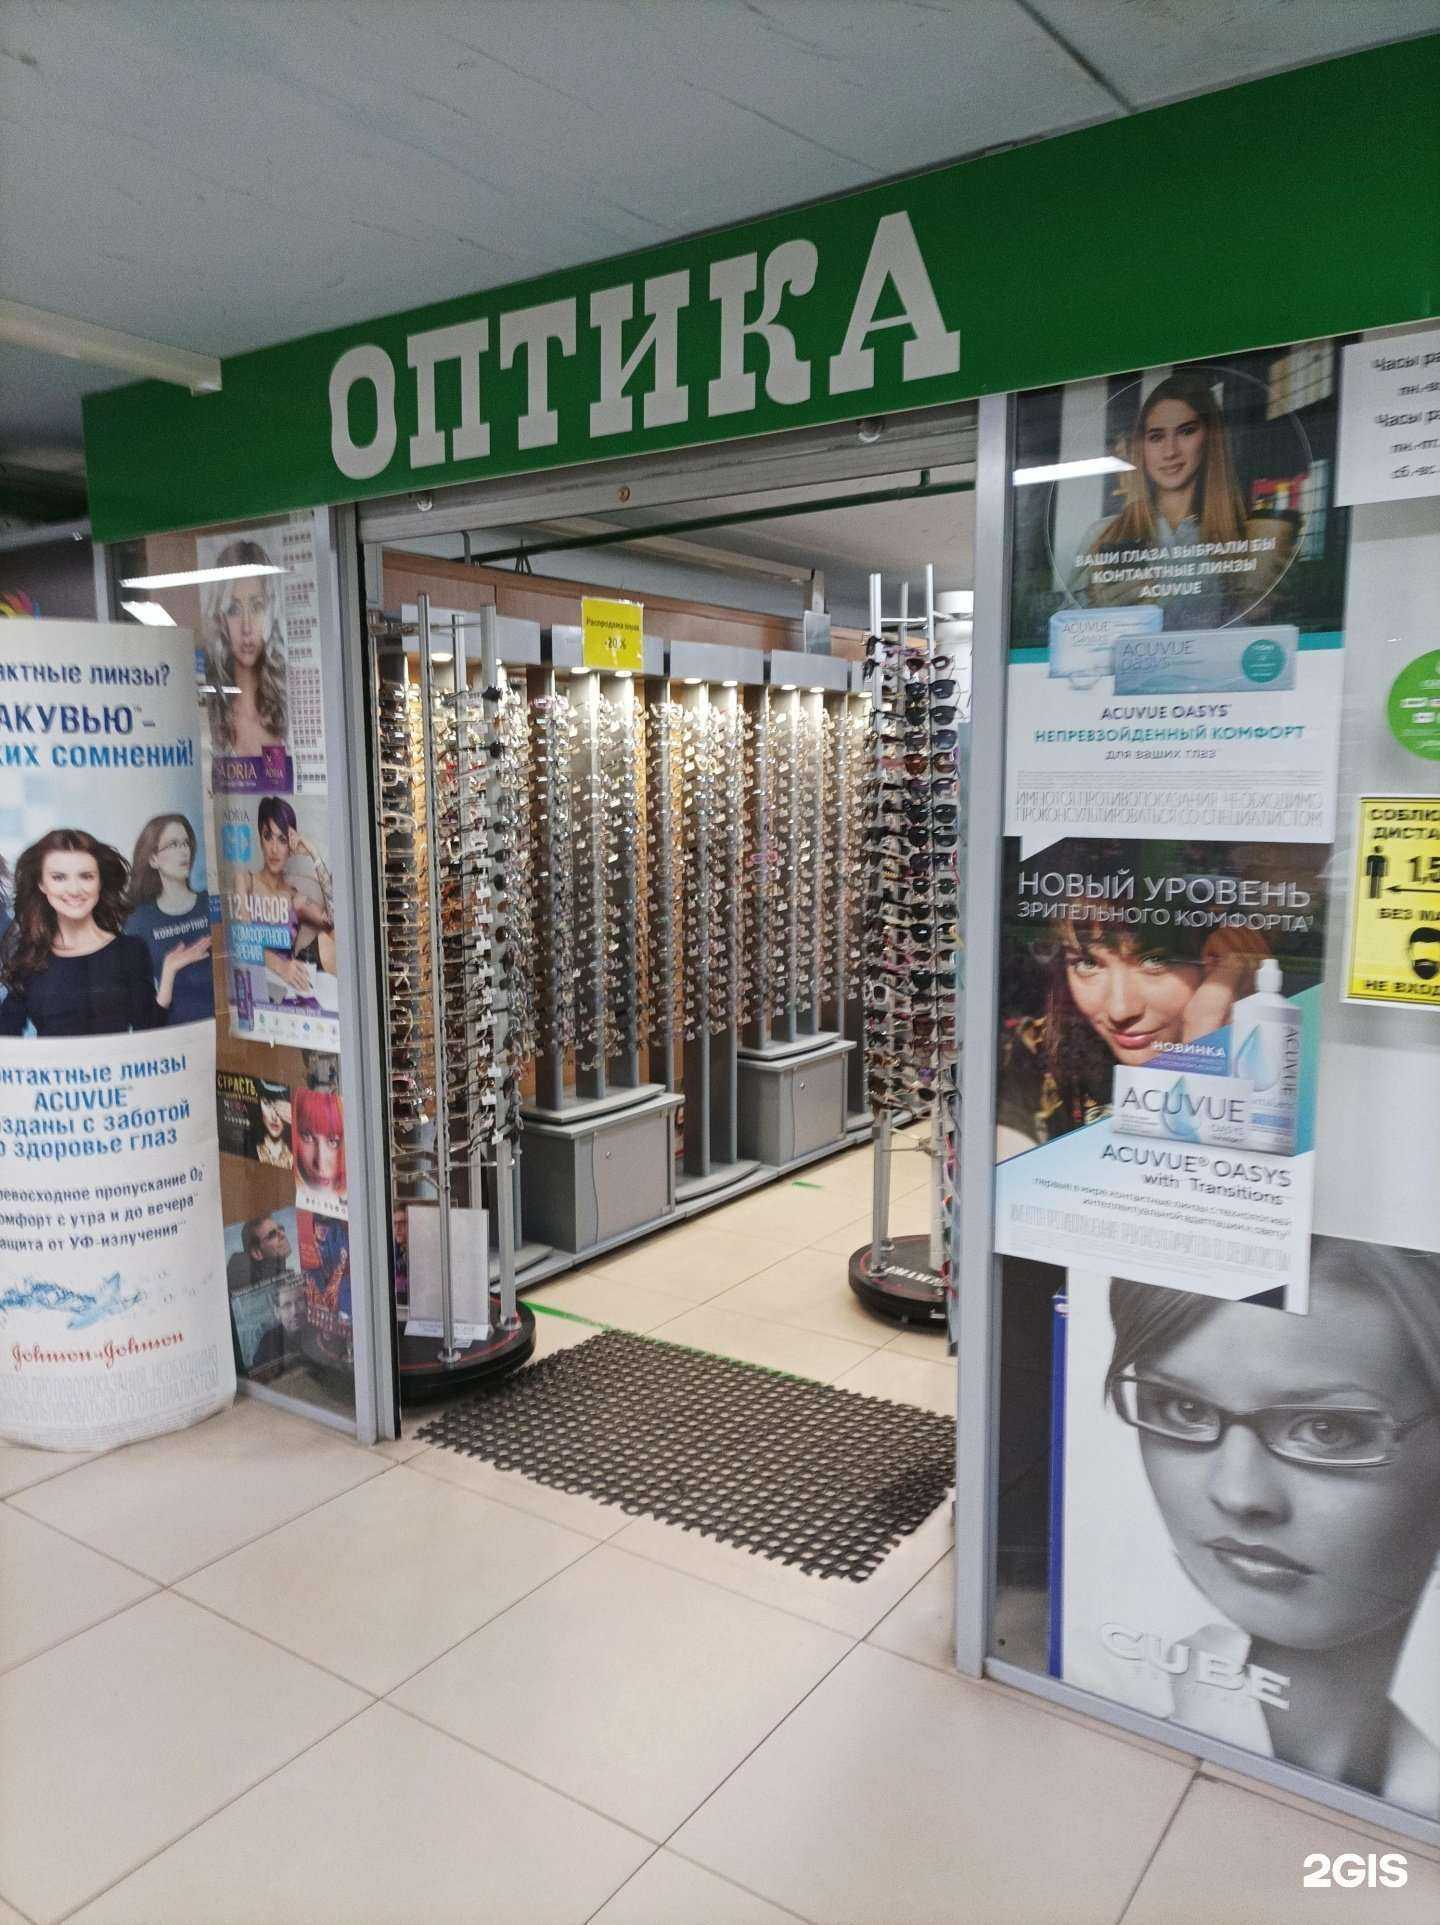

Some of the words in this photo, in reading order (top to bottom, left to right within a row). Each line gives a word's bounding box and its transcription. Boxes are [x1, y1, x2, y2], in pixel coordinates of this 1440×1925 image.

[327, 211, 961, 480] ОПТИКА
[1075, 553, 1120, 568] ВАШИ
[1121, 547, 1170, 564] ГЛАЗА
[1171, 540, 1249, 559] ВЫБРАЛИ
[1251, 537, 1276, 552] БЫ
[1091, 563, 1196, 584] КОНТАКТНЫЕ
[1198, 558, 1258, 576] ЛИНЗЫ
[1138, 581, 1203, 598] ACUVUE
[1122, 640, 1195, 656] ACUVUE
[89, 664, 171, 687] линзы?
[1101, 706, 1167, 720] ACUVUE
[1034, 725, 1208, 743] НЕПРЕВЗОЙДЕННЫЙ
[1212, 725, 1306, 740] КОМФОРТ
[0, 743, 40, 768] их
[51, 737, 194, 768] сомнений!
[1105, 750, 1131, 760] для
[1135, 750, 1181, 760] ваших
[218, 761, 258, 780] ADRIA
[1018, 868, 1134, 900] НОВЫЙ
[1143, 877, 1311, 908] УРОВЕНЬ
[244, 895, 289, 923] ЧАСОВ
[1017, 901, 1171, 926] ЗРИТЕЛЬНОГО
[1379, 908, 1413, 920] БЕЗ
[1365, 980, 1389, 992] НЕ
[1152, 1040, 1227, 1058] НОВИНКА
[0, 1065, 112, 1086] нтактные
[120, 1055, 187, 1082] линзы
[34, 1086, 129, 1112] ACUVUE
[1120, 1087, 1246, 1123] ACUVUE
[0, 1117, 74, 1138] зданы
[83, 1118, 95, 1133] с
[104, 1097, 191, 1131] заботой
[14, 1136, 123, 1162] здоровье
[130, 1128, 178, 1151] глаз
[1214, 1160, 1293, 1188] OASYS
[95, 1174, 187, 1202] пропускание
[1144, 1172, 1180, 1189] with
[1189, 1177, 1285, 1206] Transitions
[58, 1214, 66, 1225] с
[71, 1212, 106, 1229] утра
[111, 1211, 120, 1221] и
[125, 1206, 143, 1223] до
[48, 1239, 65, 1251] от
[1101, 1622, 1291, 1712] CUBE
